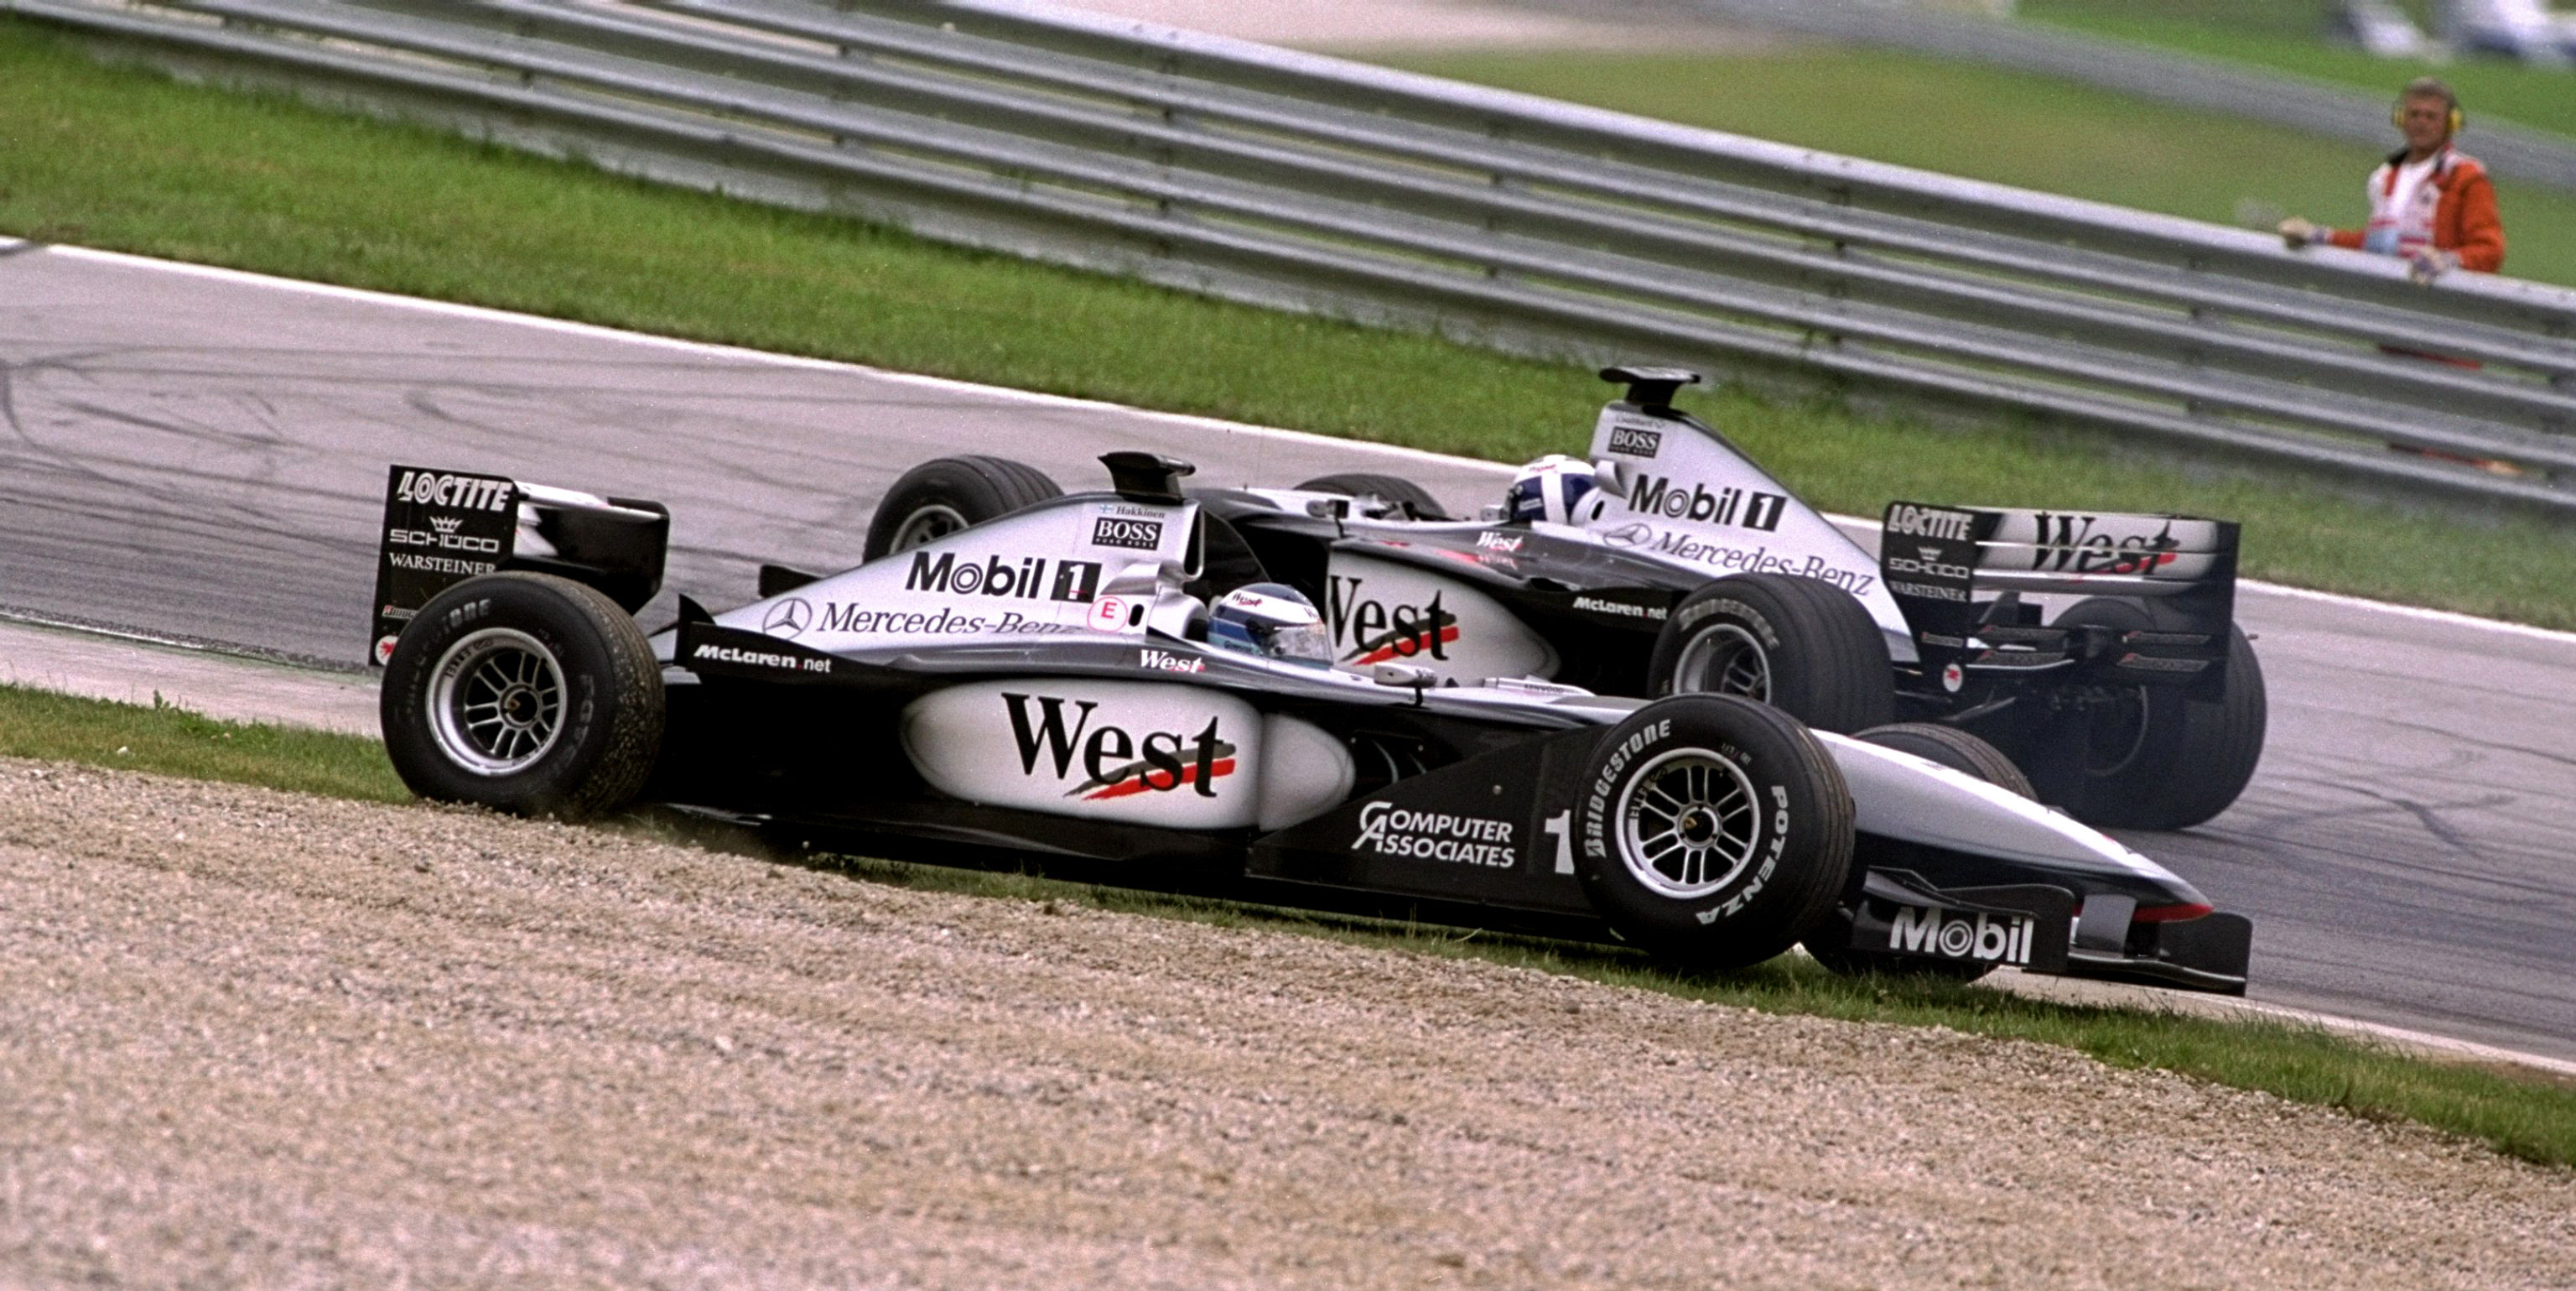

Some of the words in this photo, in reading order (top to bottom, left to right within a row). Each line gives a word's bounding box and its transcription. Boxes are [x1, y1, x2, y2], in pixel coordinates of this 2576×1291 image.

[1613, 429, 1657, 450] BOSS
[397, 471, 514, 512] LOCTITE
[1628, 473, 1742, 525] Mobil
[1097, 520, 1157, 541] BOSS
[1477, 531, 1524, 552] West
[1888, 504, 1974, 541] LOCTITE
[388, 552, 497, 576] WARSTEINER
[1650, 532, 1875, 596] Mercedes-Benz
[2032, 514, 2175, 575] West
[905, 551, 1046, 599] Mobil
[1100, 601, 1118, 619] E
[1573, 596, 1667, 619] McLaren.net
[693, 644, 831, 673] McLaren.net
[1141, 649, 1202, 674] West
[1000, 693, 1228, 798] West
[1584, 719, 1671, 858] BRIDGESTONE
[1351, 815, 1515, 867] ASSOCIATES
[1360, 801, 1513, 842] COMPUTER
[1696, 786, 1789, 924] POTENZA
[1889, 906, 2034, 964] Mobil
